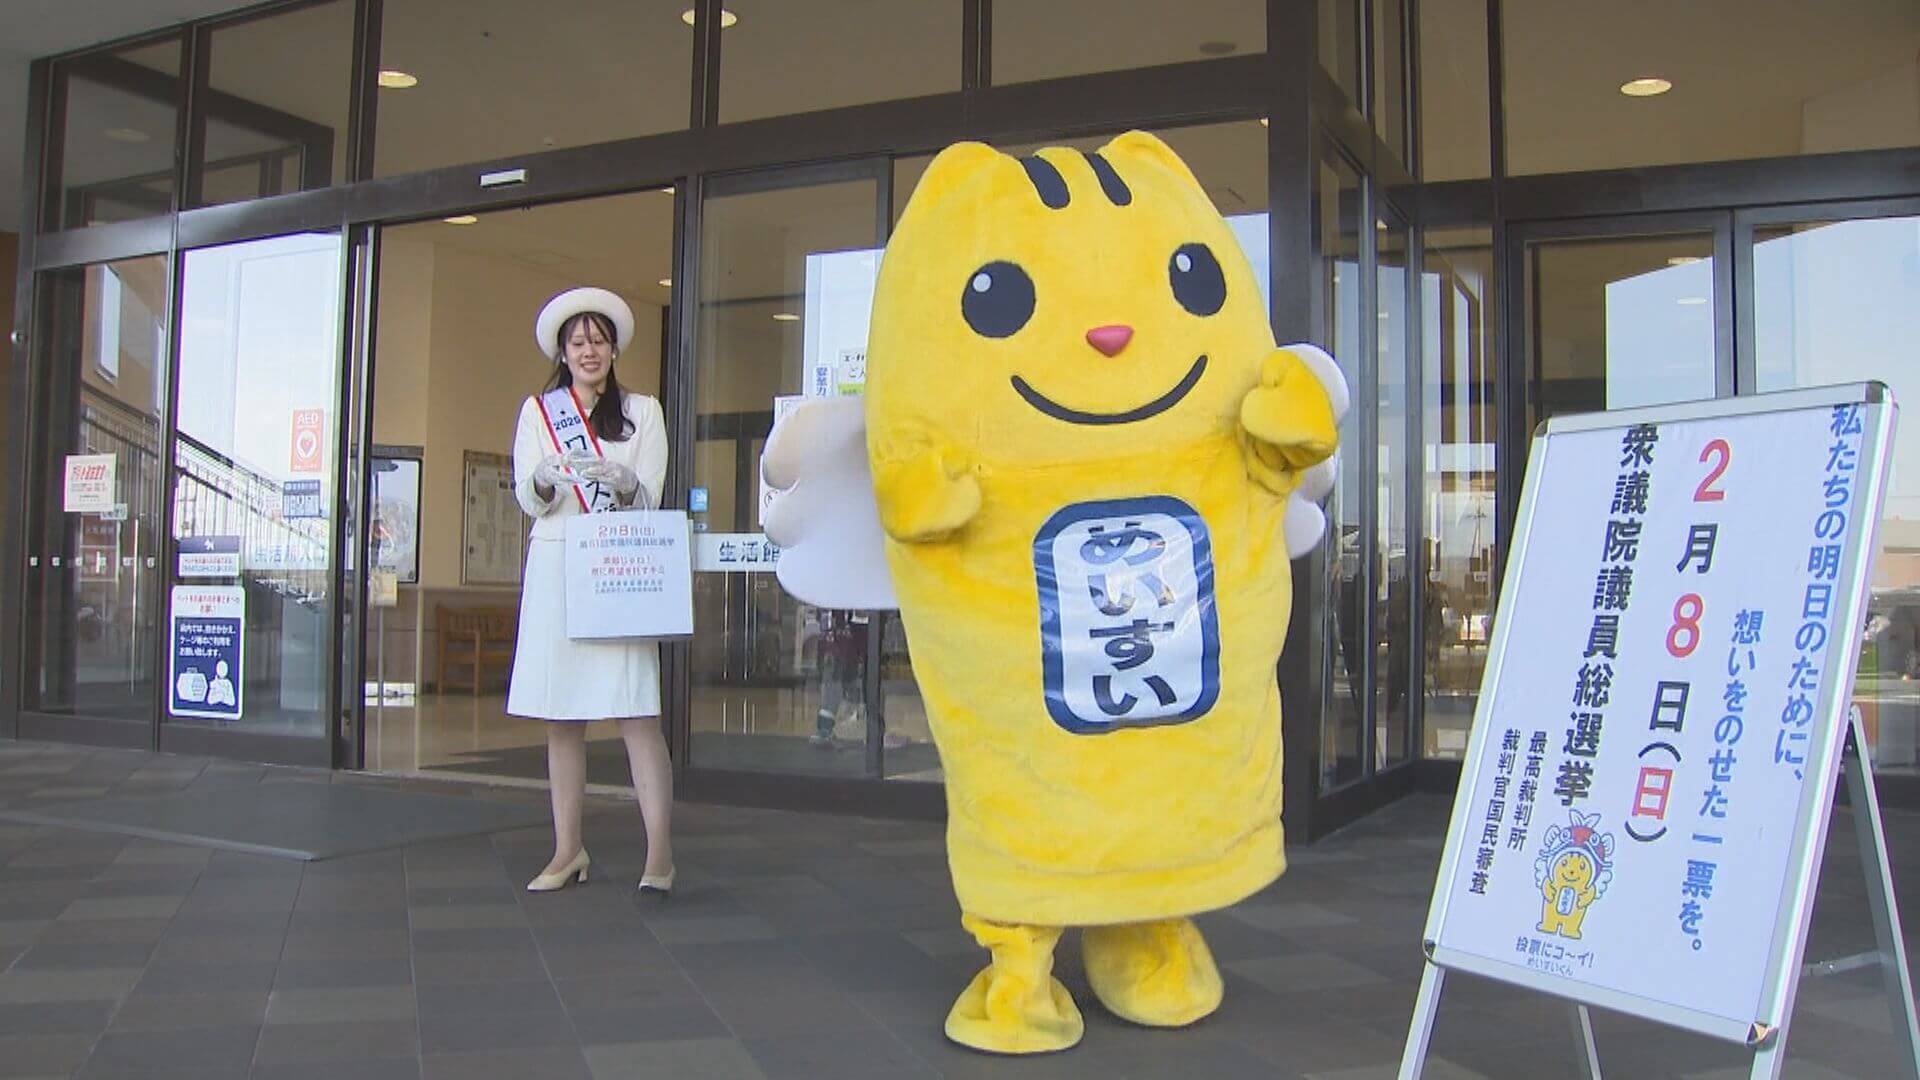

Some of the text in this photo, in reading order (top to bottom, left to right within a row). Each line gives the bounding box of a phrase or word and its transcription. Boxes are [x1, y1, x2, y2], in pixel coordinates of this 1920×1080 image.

[297, 413, 319, 426] AED
[719, 541, 780, 562] 生活館
[1079, 521, 1177, 716] めいすい
[1553, 423, 1658, 808] 衆議院議員総選挙
[1775, 403, 1861, 780] 私たちの明日のために、
[1469, 729, 1520, 895] 裁判官国民審査
[1507, 731, 1548, 851] 最高裁判所
[1678, 609, 1764, 951] 想いをのせた一票を。
